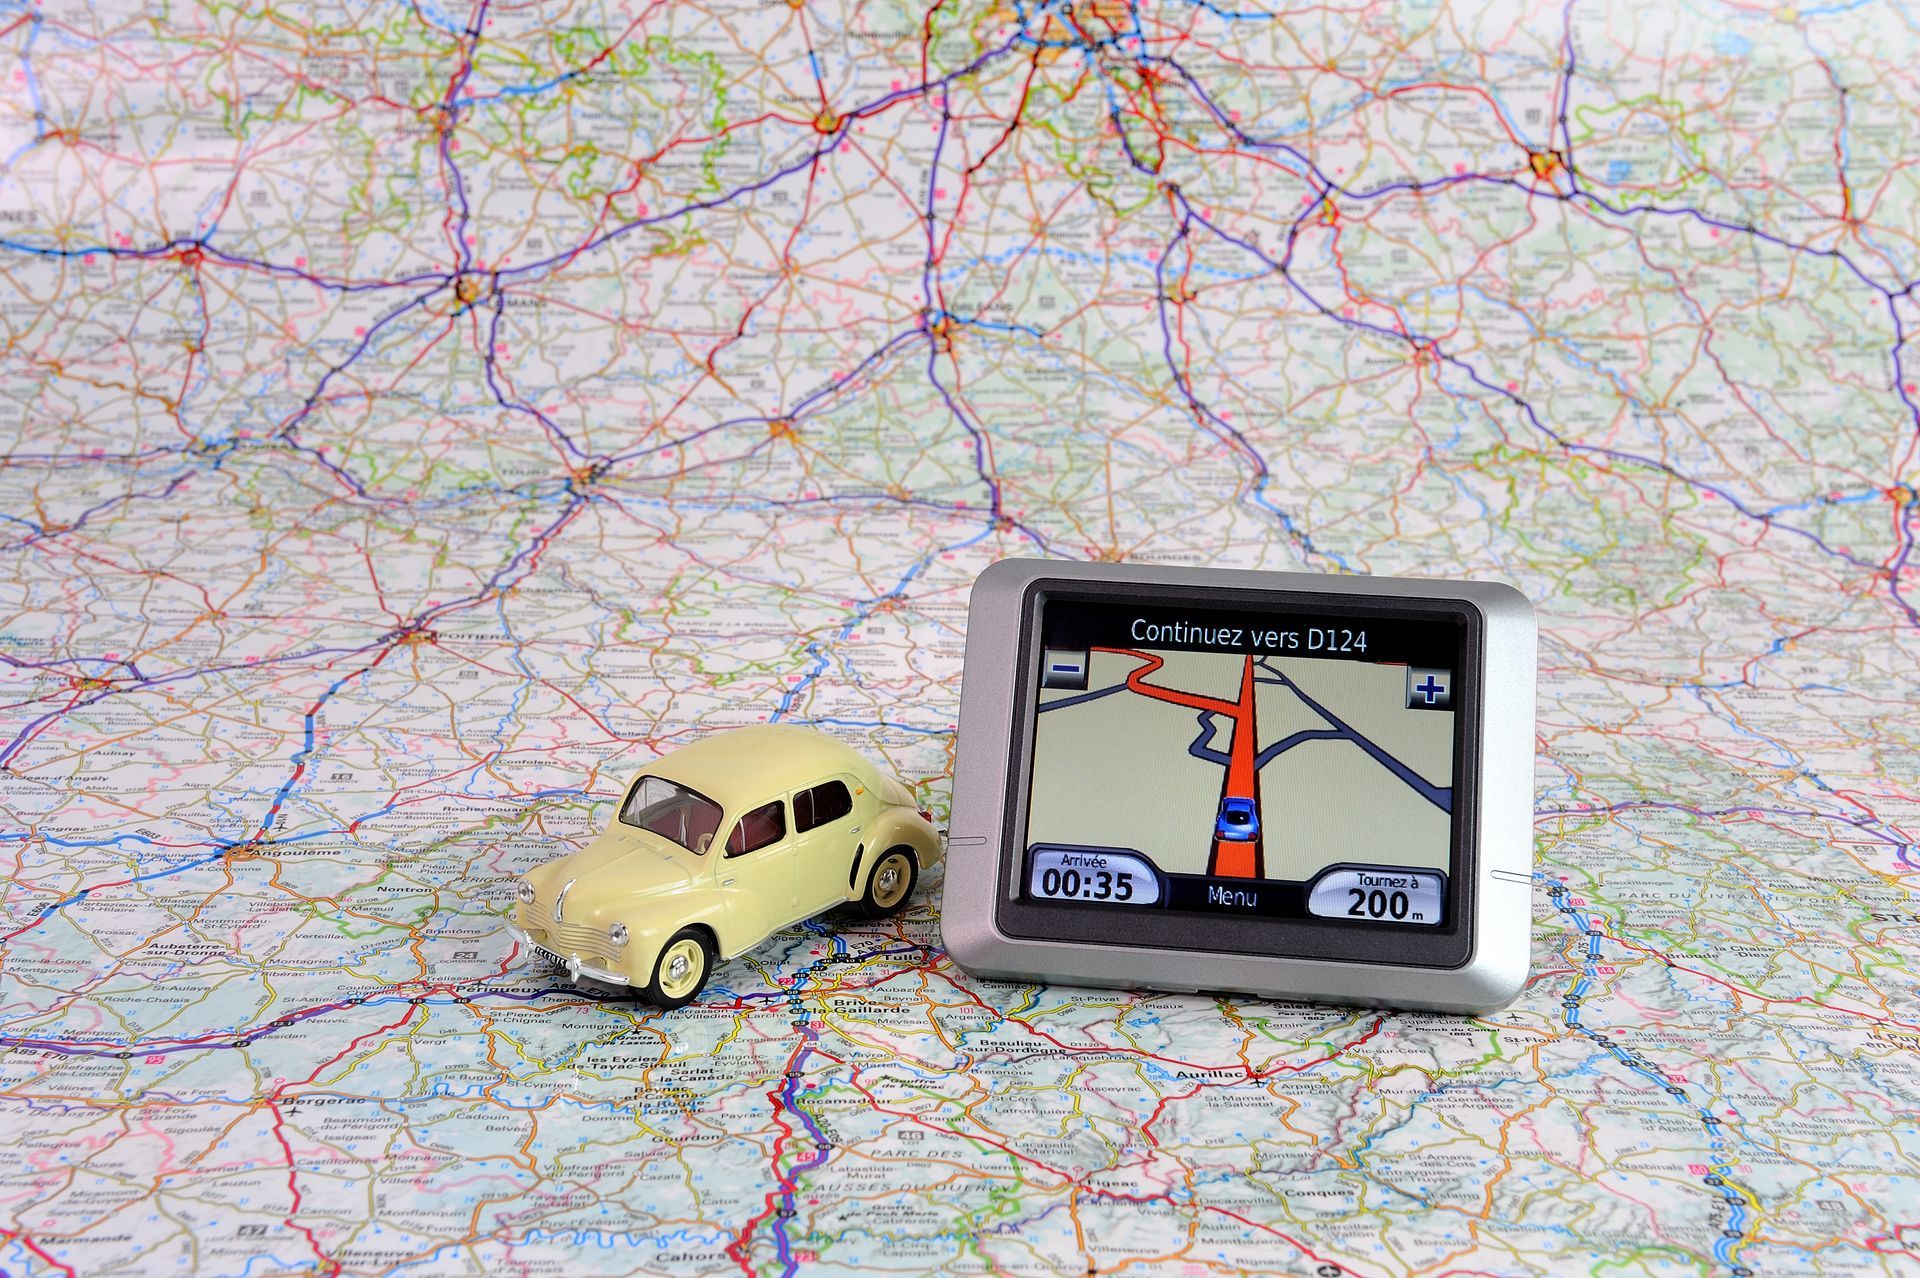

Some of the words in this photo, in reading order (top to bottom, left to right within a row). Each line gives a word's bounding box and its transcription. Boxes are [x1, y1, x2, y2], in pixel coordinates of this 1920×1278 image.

[1131, 618, 1243, 646] Continuez
[1252, 629, 1299, 649] vers
[1308, 629, 1368, 652] D124
[1061, 853, 1107, 868] Arrivée
[1042, 868, 1133, 901] 00:35
[1358, 872, 1407, 888] Tournez
[1411, 875, 1419, 889] à
[1209, 886, 1257, 907] Menu
[1348, 888, 1409, 919] 200
[1412, 911, 1423, 920] m
[455, 985, 541, 994] Périgueux
[612, 1056, 658, 1064] Eyzies
[1176, 1070, 1242, 1078] Aurillac
[283, 1097, 366, 1105] Bergerac
